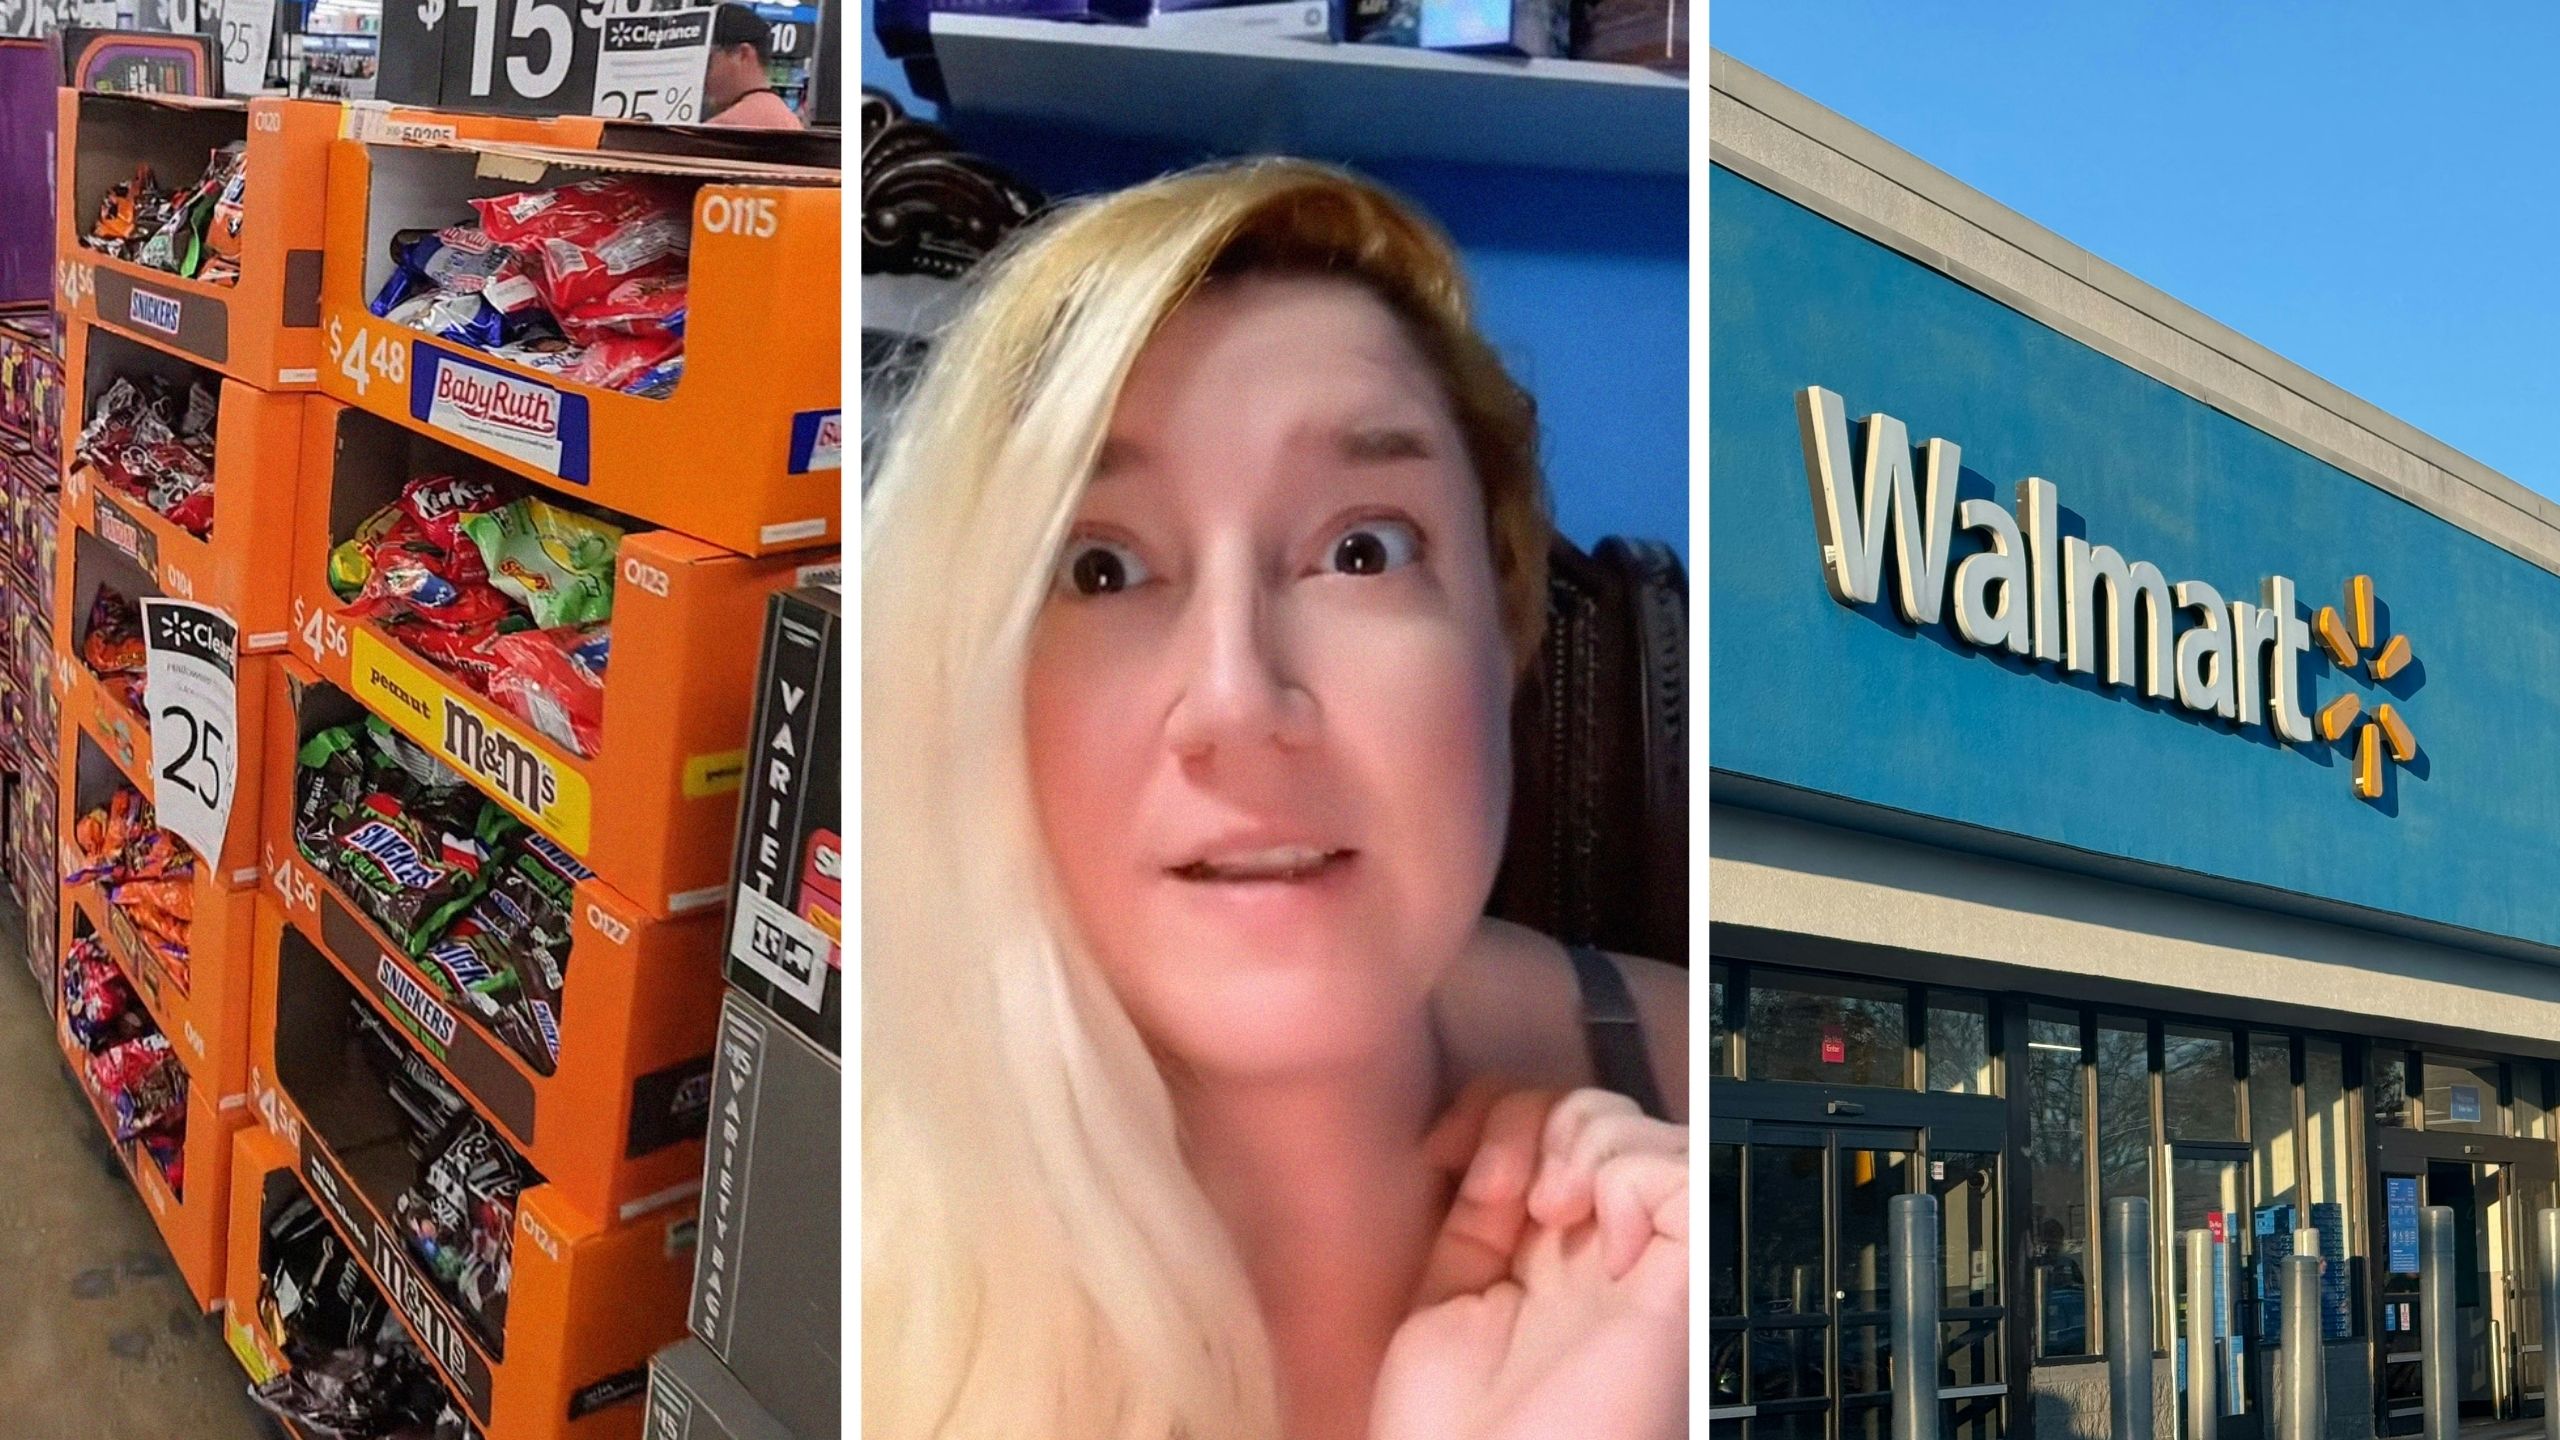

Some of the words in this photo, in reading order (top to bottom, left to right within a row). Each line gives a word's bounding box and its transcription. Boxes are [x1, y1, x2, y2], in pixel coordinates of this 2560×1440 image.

[224, 21, 252, 64] 25
[131, 291, 179, 332] SNICKERS
[1797, 385, 2313, 743] Walmart
[370, 667, 432, 720] peanut
[163, 706, 223, 810] 25
[381, 959, 453, 1041] SNICKERS
